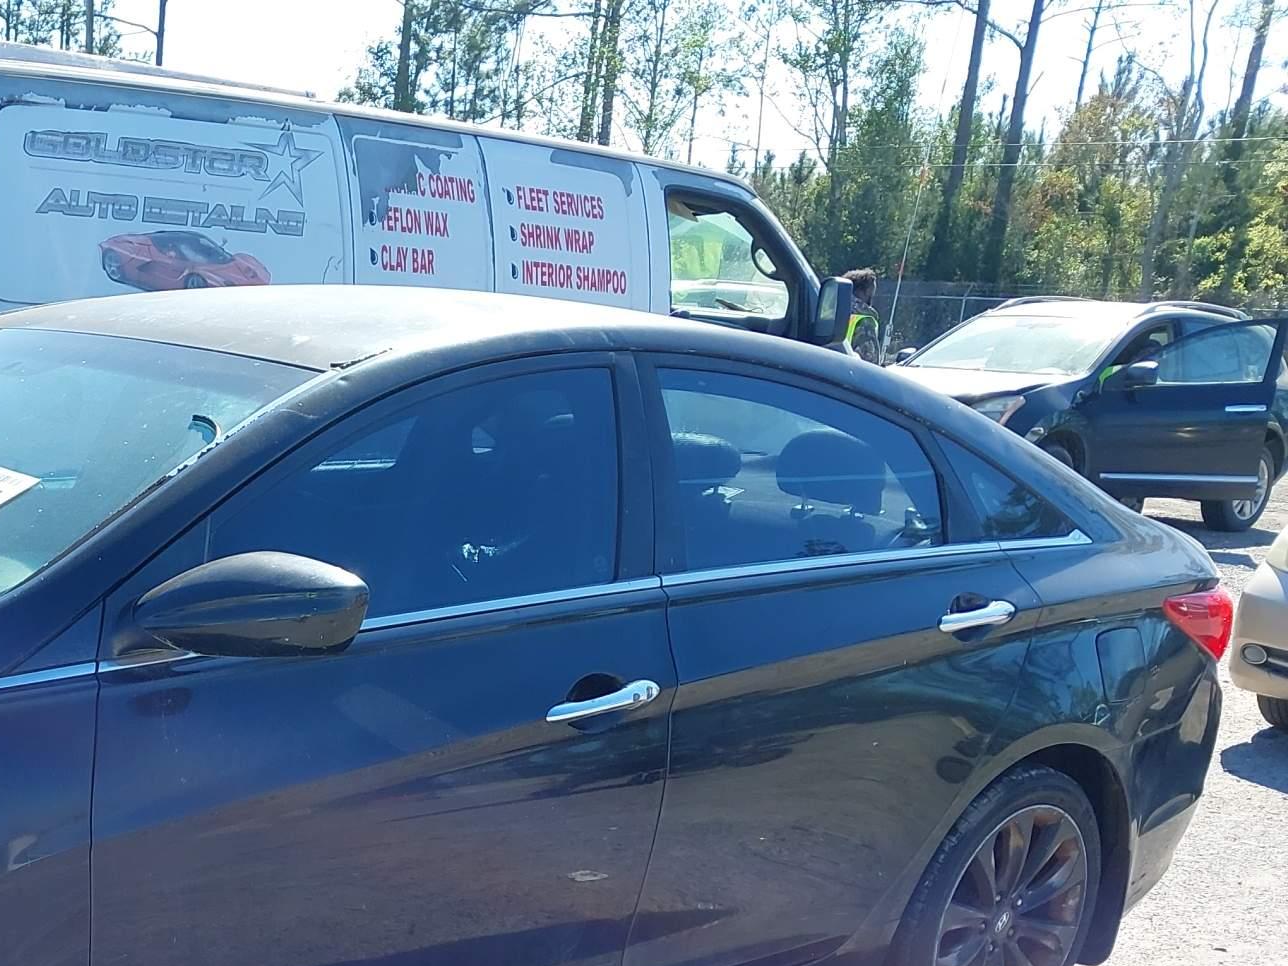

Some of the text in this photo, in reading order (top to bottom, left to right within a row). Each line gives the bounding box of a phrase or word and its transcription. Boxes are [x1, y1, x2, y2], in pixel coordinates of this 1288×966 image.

[35, 187, 139, 221] AUTO
[427, 173, 476, 204] COATING
[516, 185, 604, 220] FLEET SERVICES
[424, 210, 450, 238] WAX
[520, 222, 595, 254] SHRINK WRAP
[380, 245, 435, 275] CLAY BAR
[522, 260, 627, 295] INTERIOR SHAMPOO
